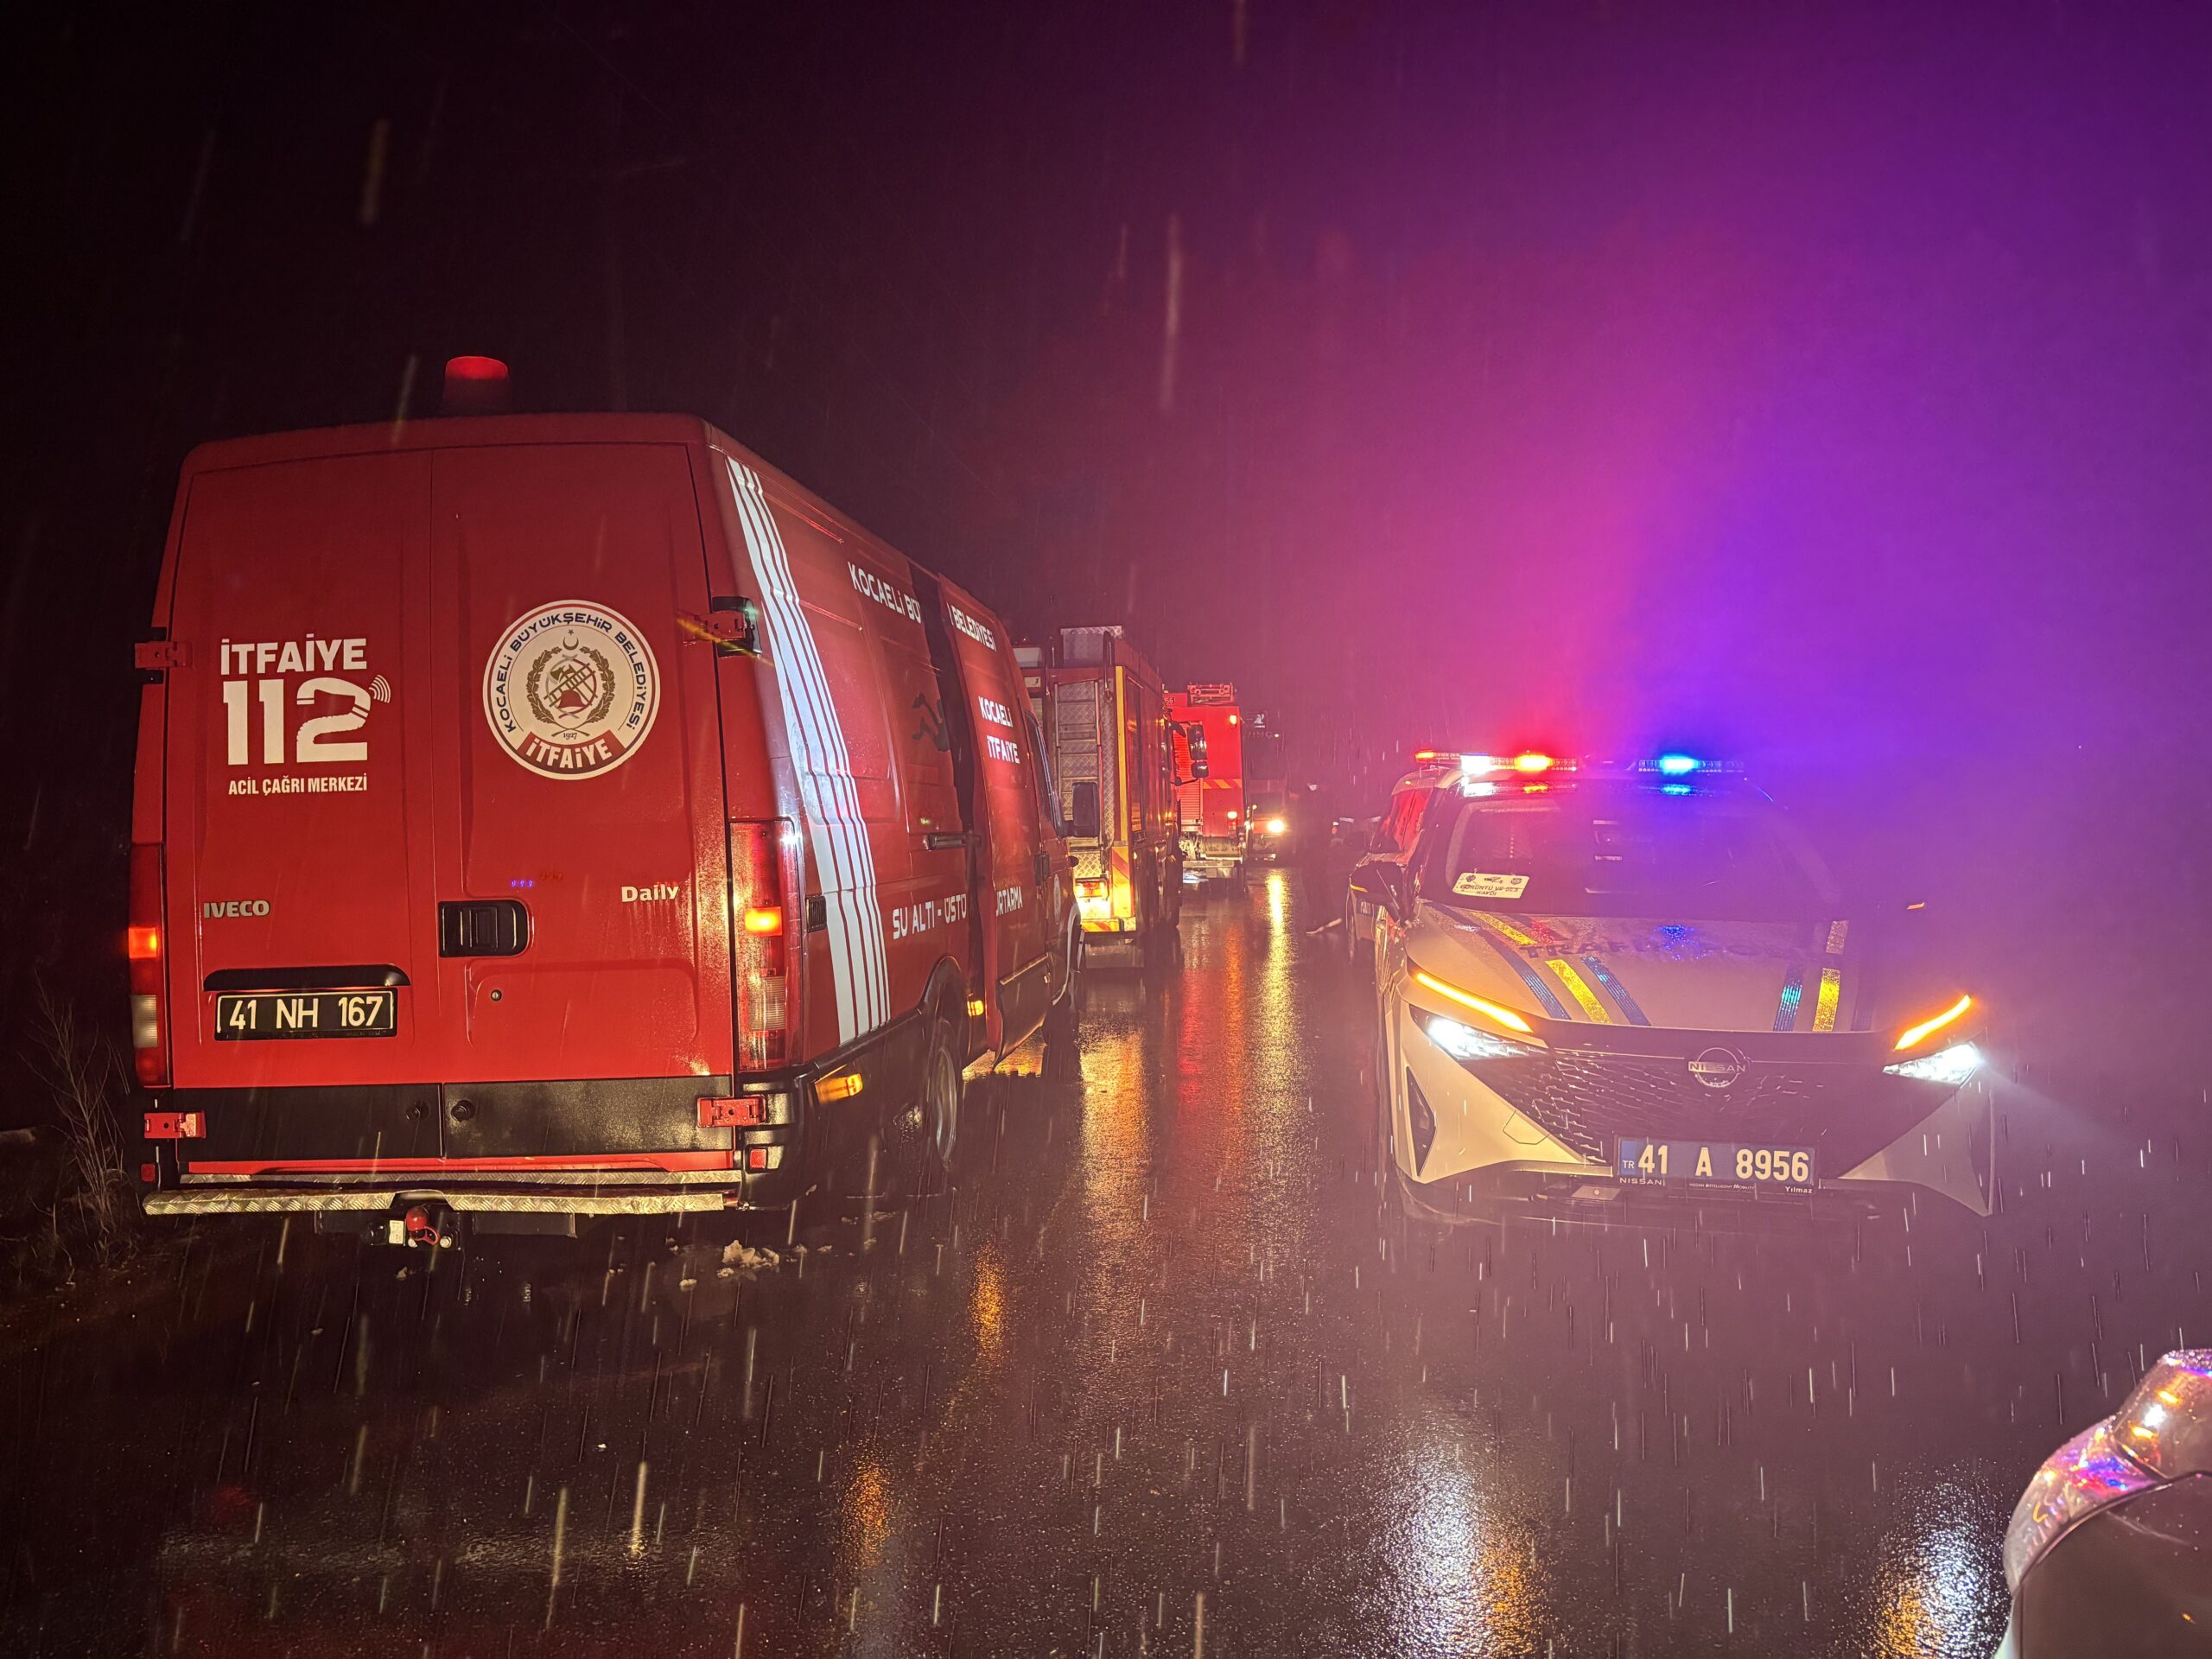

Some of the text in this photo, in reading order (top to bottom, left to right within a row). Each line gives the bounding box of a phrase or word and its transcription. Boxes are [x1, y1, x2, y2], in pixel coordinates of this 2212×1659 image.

[221, 633, 367, 675] İTFAİYE
[496, 612, 646, 733] KOCAELİ BÜYÜKŞEHİR BELEDİYESİ
[223, 677, 372, 766] 112
[978, 696, 1013, 728] KOCAELİ
[525, 738, 613, 769] İTFAİYE
[987, 734, 1020, 764] İTFAİYE
[228, 772, 367, 796] ACİL ÇAĞRI MERKEZİ
[203, 899, 270, 918] IVECO
[621, 884, 679, 902] Daily
[893, 906, 907, 940] SU
[912, 900, 935, 934] ALTI
[229, 996, 384, 1030] 41 NH 167
[1623, 1144, 1809, 1182] TR 41 A 8956
